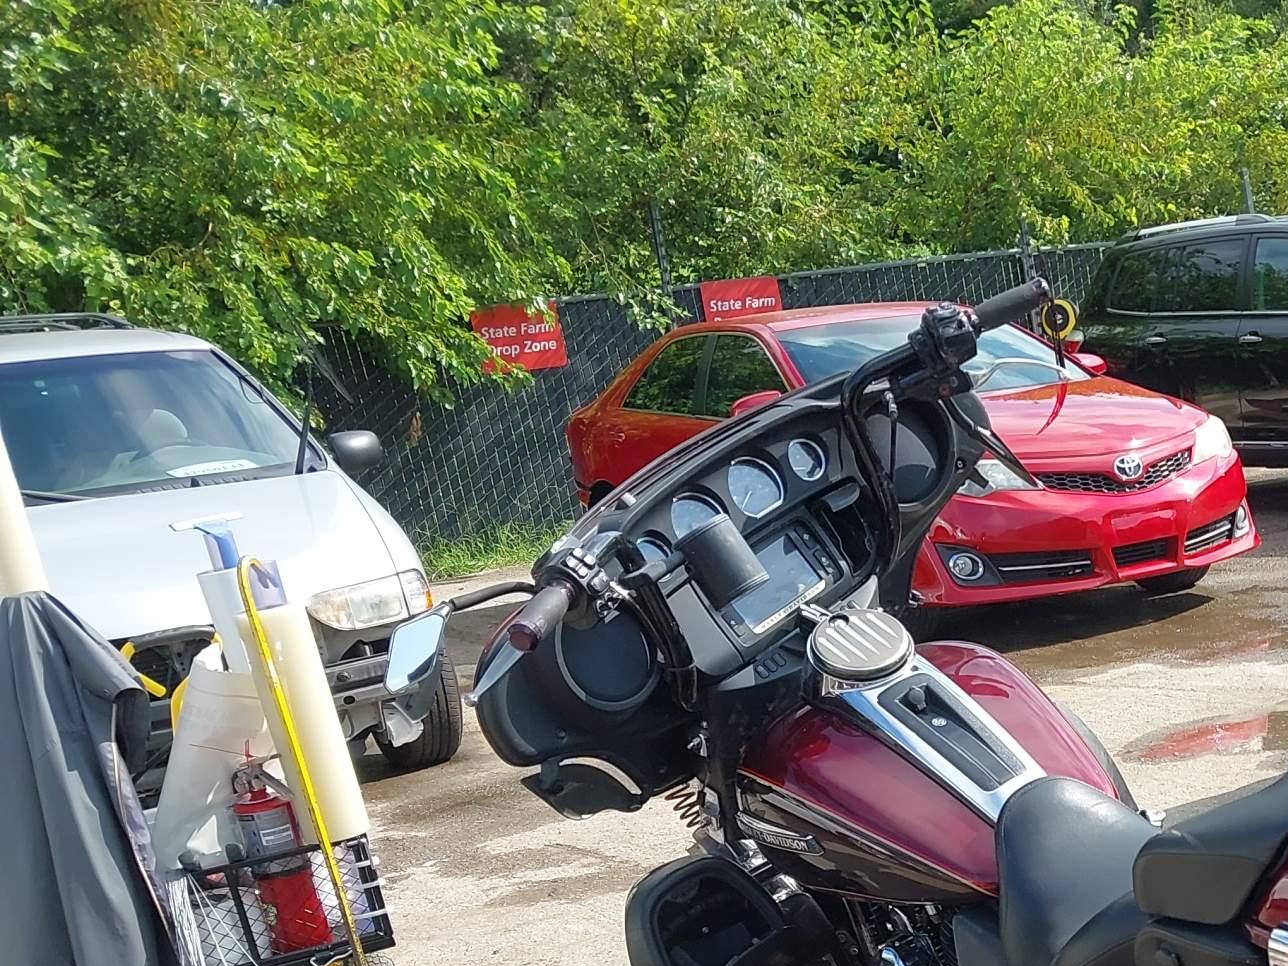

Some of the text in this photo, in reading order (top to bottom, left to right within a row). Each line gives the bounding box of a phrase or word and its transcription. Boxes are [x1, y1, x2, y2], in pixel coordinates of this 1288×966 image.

[709, 296, 775, 312] State Farm
[481, 326, 517, 339] State
[523, 340, 557, 353] Zone
